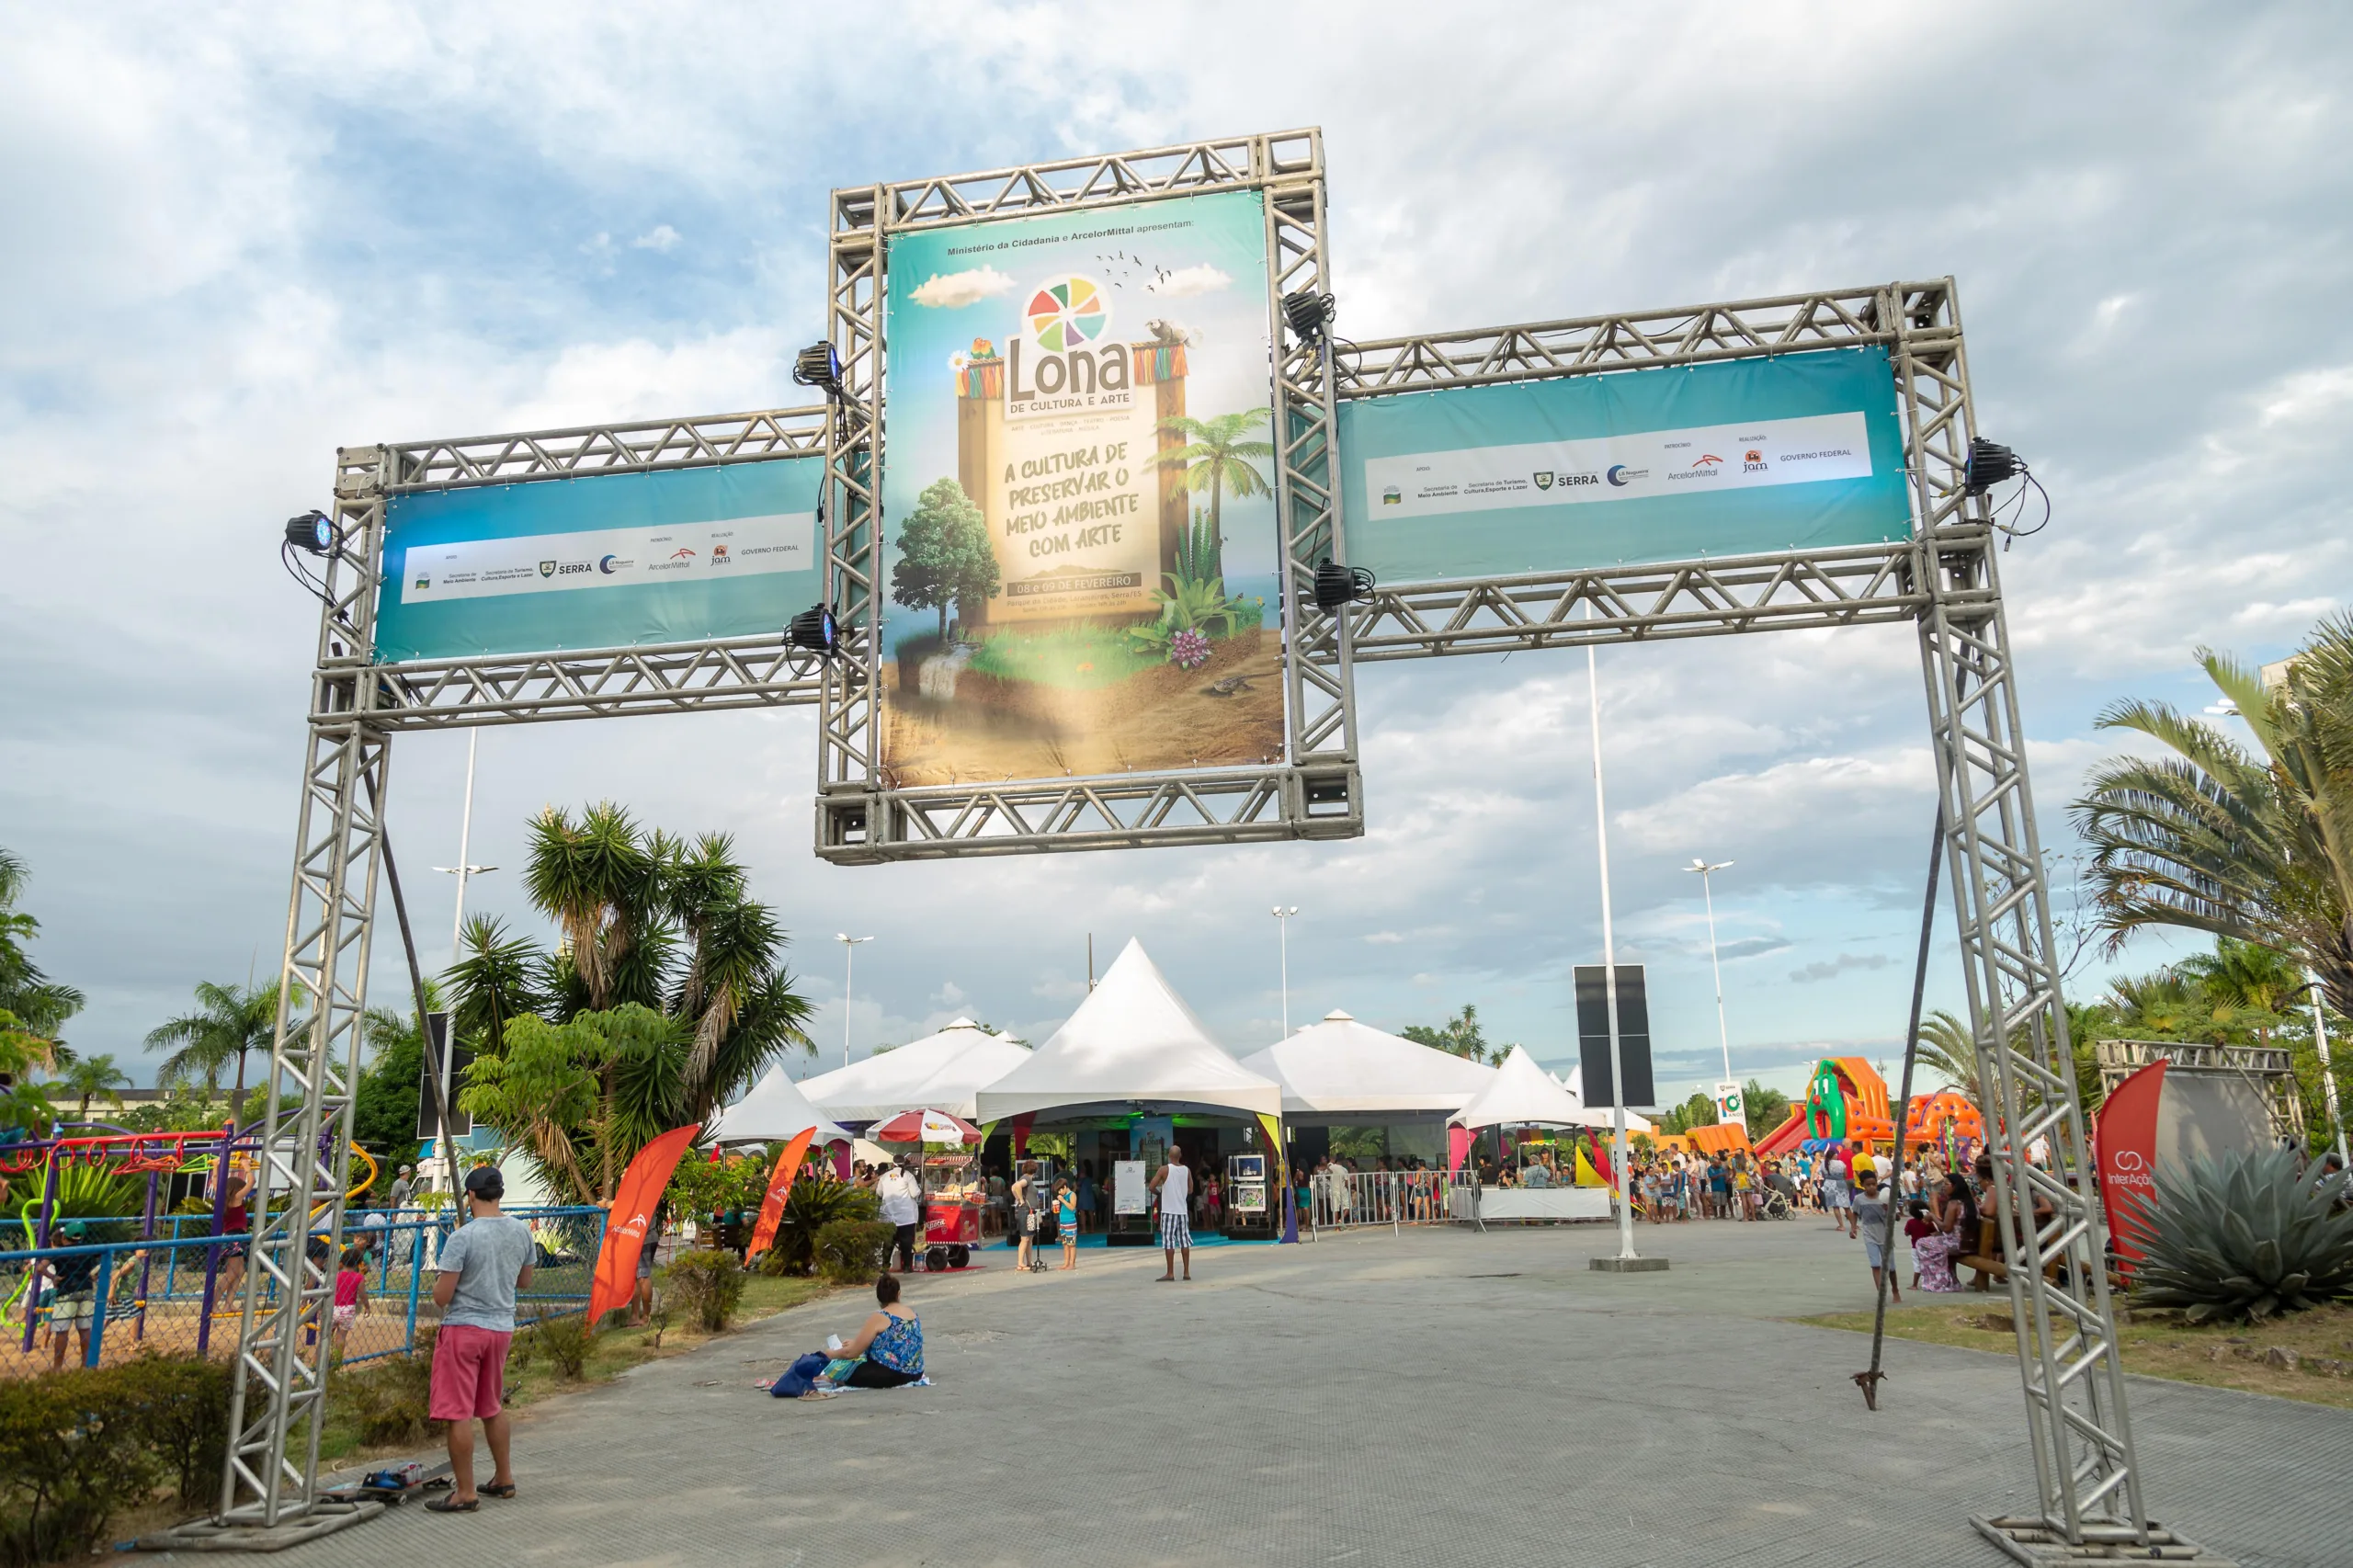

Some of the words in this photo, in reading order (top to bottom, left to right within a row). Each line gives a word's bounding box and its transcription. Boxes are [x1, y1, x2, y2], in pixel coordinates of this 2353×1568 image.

[948, 244, 995, 256] Ministério
[997, 242, 1009, 250] da
[1012, 235, 1060, 248] Cidadania
[1071, 226, 1134, 240] ArcelorMittal
[1137, 220, 1194, 233] apresentam:
[1010, 338, 1130, 403] Lona
[1011, 403, 1025, 414] DE
[1030, 398, 1083, 412] CULTURA
[1088, 396, 1095, 405] E
[1100, 393, 1130, 404] ARTE
[1005, 463, 1016, 483] A
[1021, 445, 1099, 479] CULTURA
[1106, 441, 1128, 464] DE
[1780, 451, 1818, 462] GOVERNO
[1819, 449, 1851, 460] FEDERAL
[1743, 461, 1768, 473] jam
[1558, 475, 1599, 487] SERRA
[1667, 469, 1718, 481] ArcelorMittal
[1009, 471, 1110, 510] PRESERVAR
[1115, 467, 1129, 486] O
[1424, 484, 1449, 493] Secretaria
[1431, 490, 1458, 498] Ambiente
[1006, 511, 1047, 536] MEIO
[1052, 494, 1139, 527] AMBIENTE
[1029, 533, 1070, 558] COM
[1075, 524, 1122, 549] ARTE
[741, 547, 772, 555] GOVERNO
[772, 544, 799, 552] FEDERAL
[648, 561, 690, 571] ArcelorMittal
[710, 555, 731, 566] jam
[559, 563, 593, 574] SERRA
[1017, 584, 1030, 594] 08
[1032, 585, 1039, 593] e
[1041, 582, 1055, 592] 09
[1058, 580, 1072, 590] DE
[1074, 575, 1131, 589] FEVEREIRO
[1006, 599, 1029, 608] Parque
[1111, 590, 1142, 599] Serra/ES
